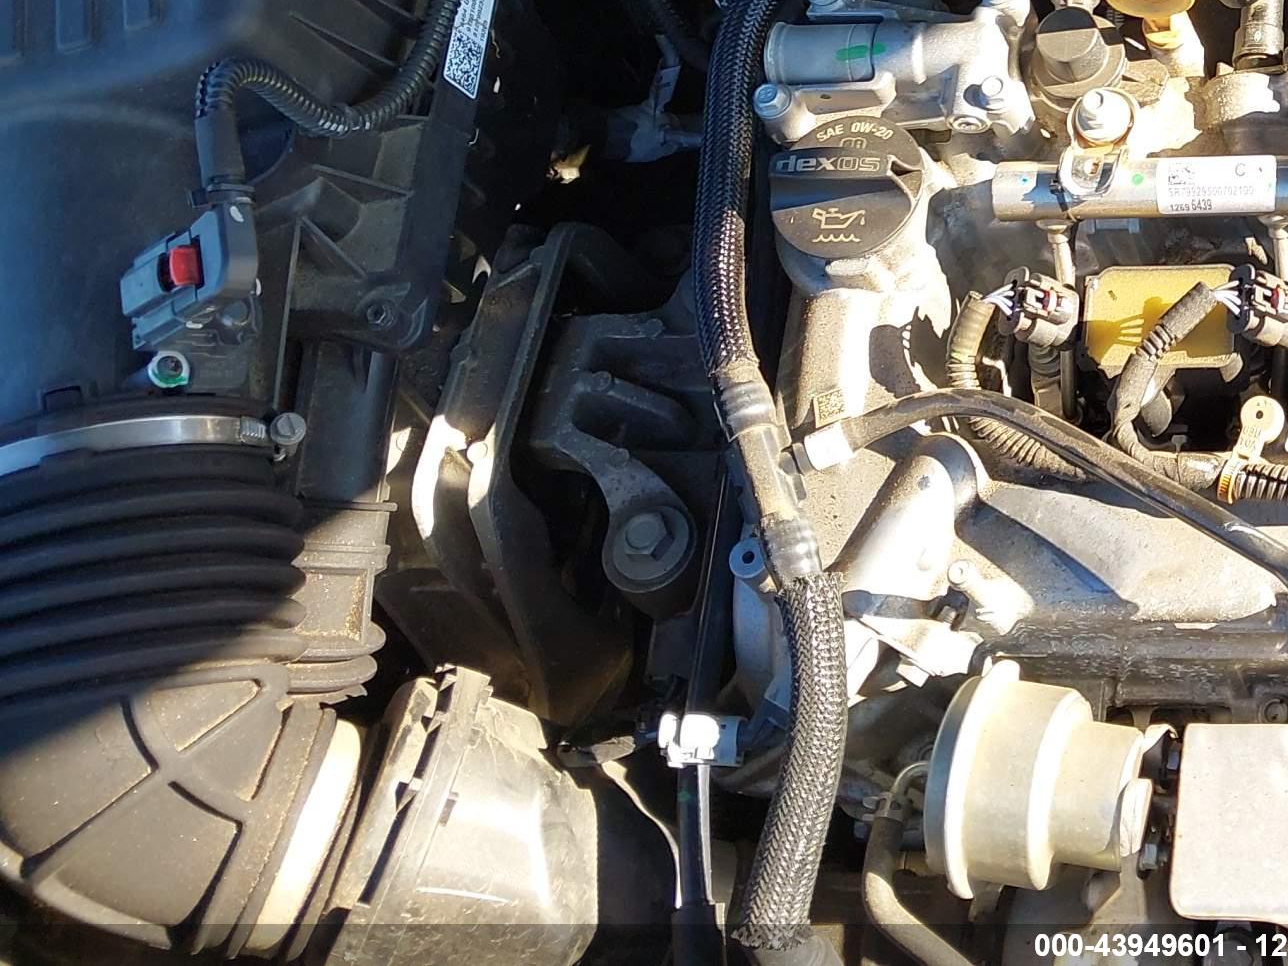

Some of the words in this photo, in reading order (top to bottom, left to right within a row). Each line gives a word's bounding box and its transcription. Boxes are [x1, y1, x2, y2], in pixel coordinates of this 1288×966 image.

[816, 124, 845, 142] SAE
[851, 121, 894, 140] 0W-20
[775, 154, 881, 172] dexos
